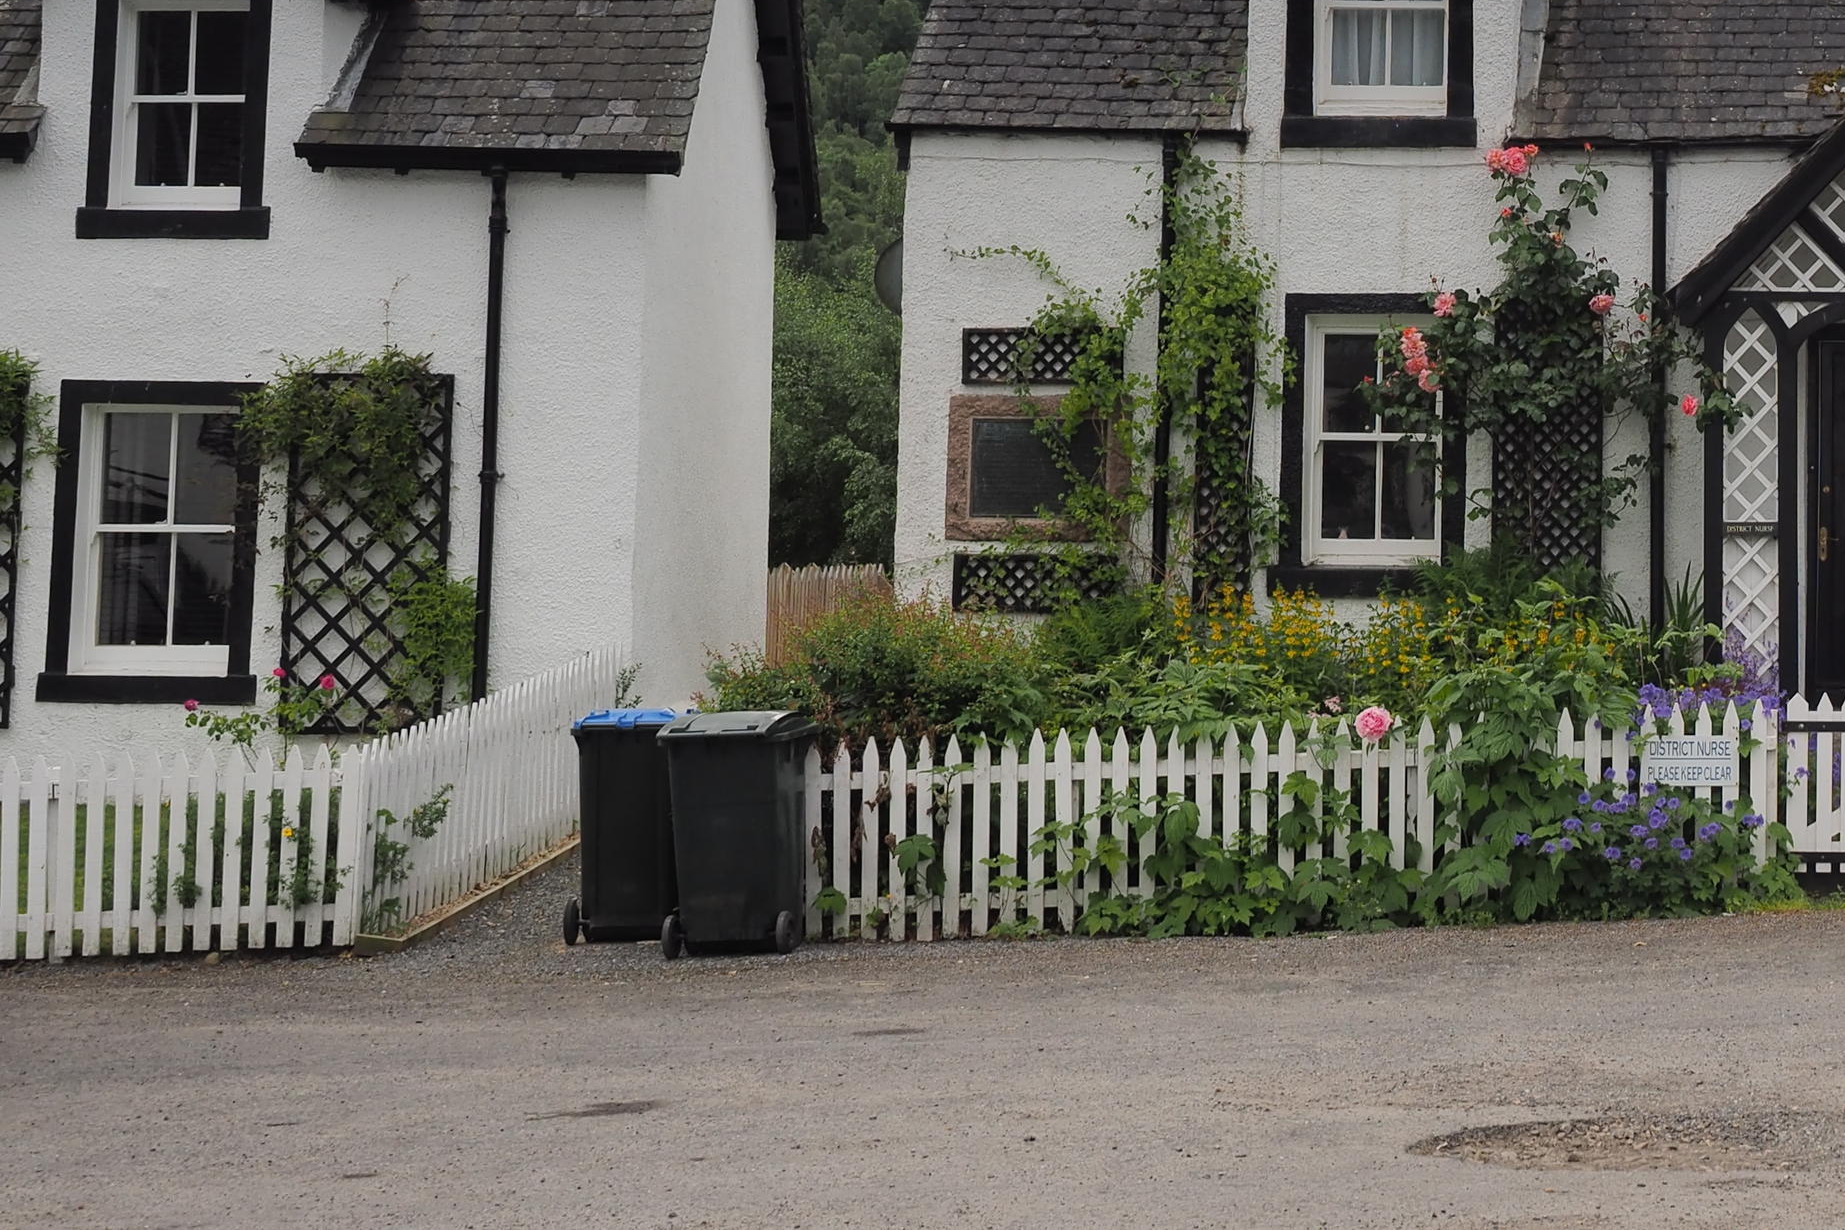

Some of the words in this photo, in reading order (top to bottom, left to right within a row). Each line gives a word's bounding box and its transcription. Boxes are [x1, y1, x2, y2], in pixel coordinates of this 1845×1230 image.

[1649, 741, 1694, 756] DISTRICT
[1697, 741, 1731, 756] NURSE
[1648, 766, 1679, 781] PLEASE
[1681, 766, 1702, 781] KEEP
[1705, 766, 1732, 781] CLEAR
